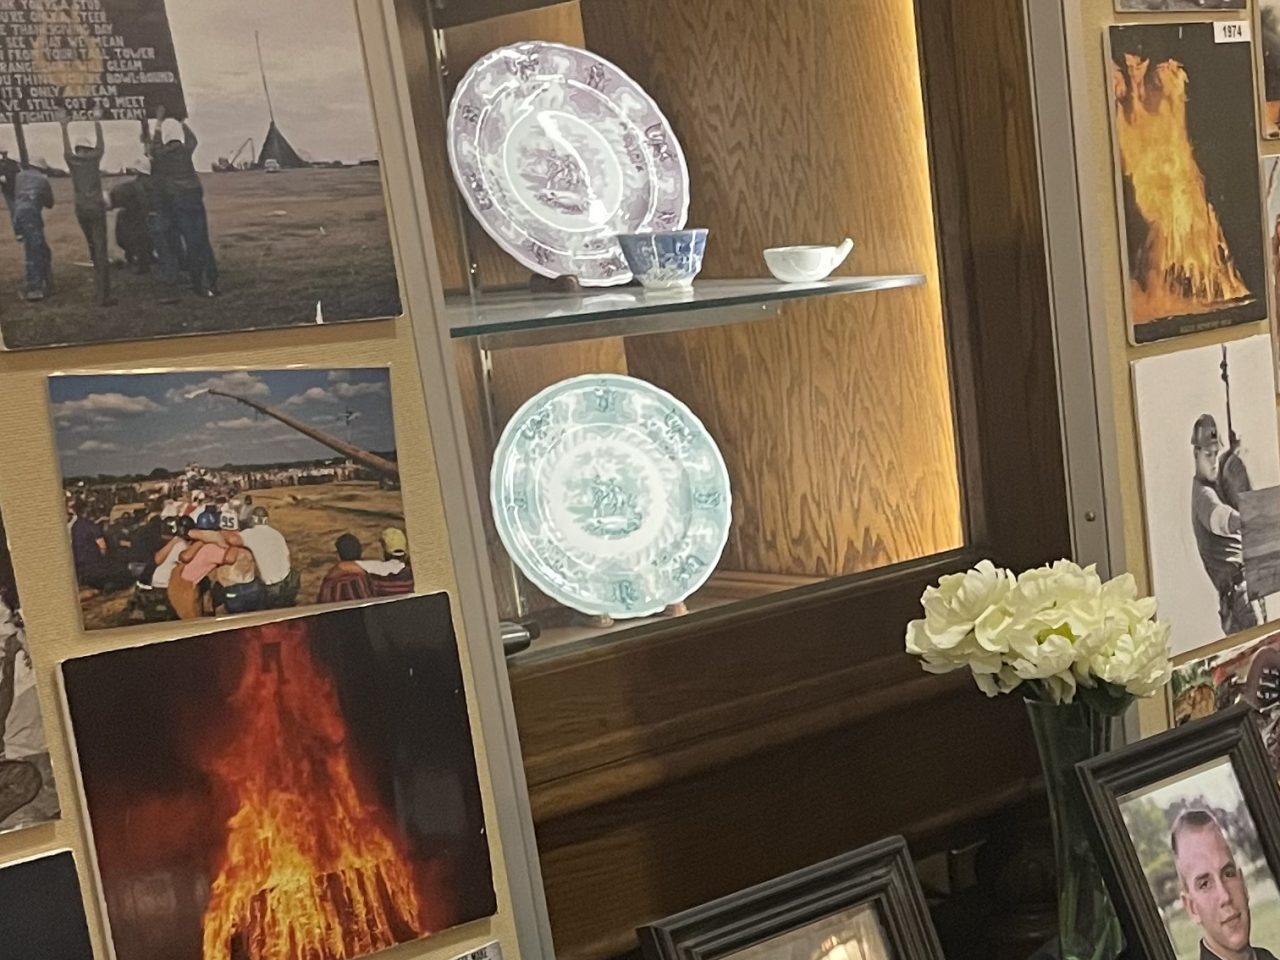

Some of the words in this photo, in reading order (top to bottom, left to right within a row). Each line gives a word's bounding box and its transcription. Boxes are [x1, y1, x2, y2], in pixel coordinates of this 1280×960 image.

[1223, 24, 1242, 38] 1974
[114, 47, 155, 59] TOWER
[107, 60, 142, 72] GLEAM
[30, 86, 60, 98] ONLY
[115, 96, 145, 108] MEET
